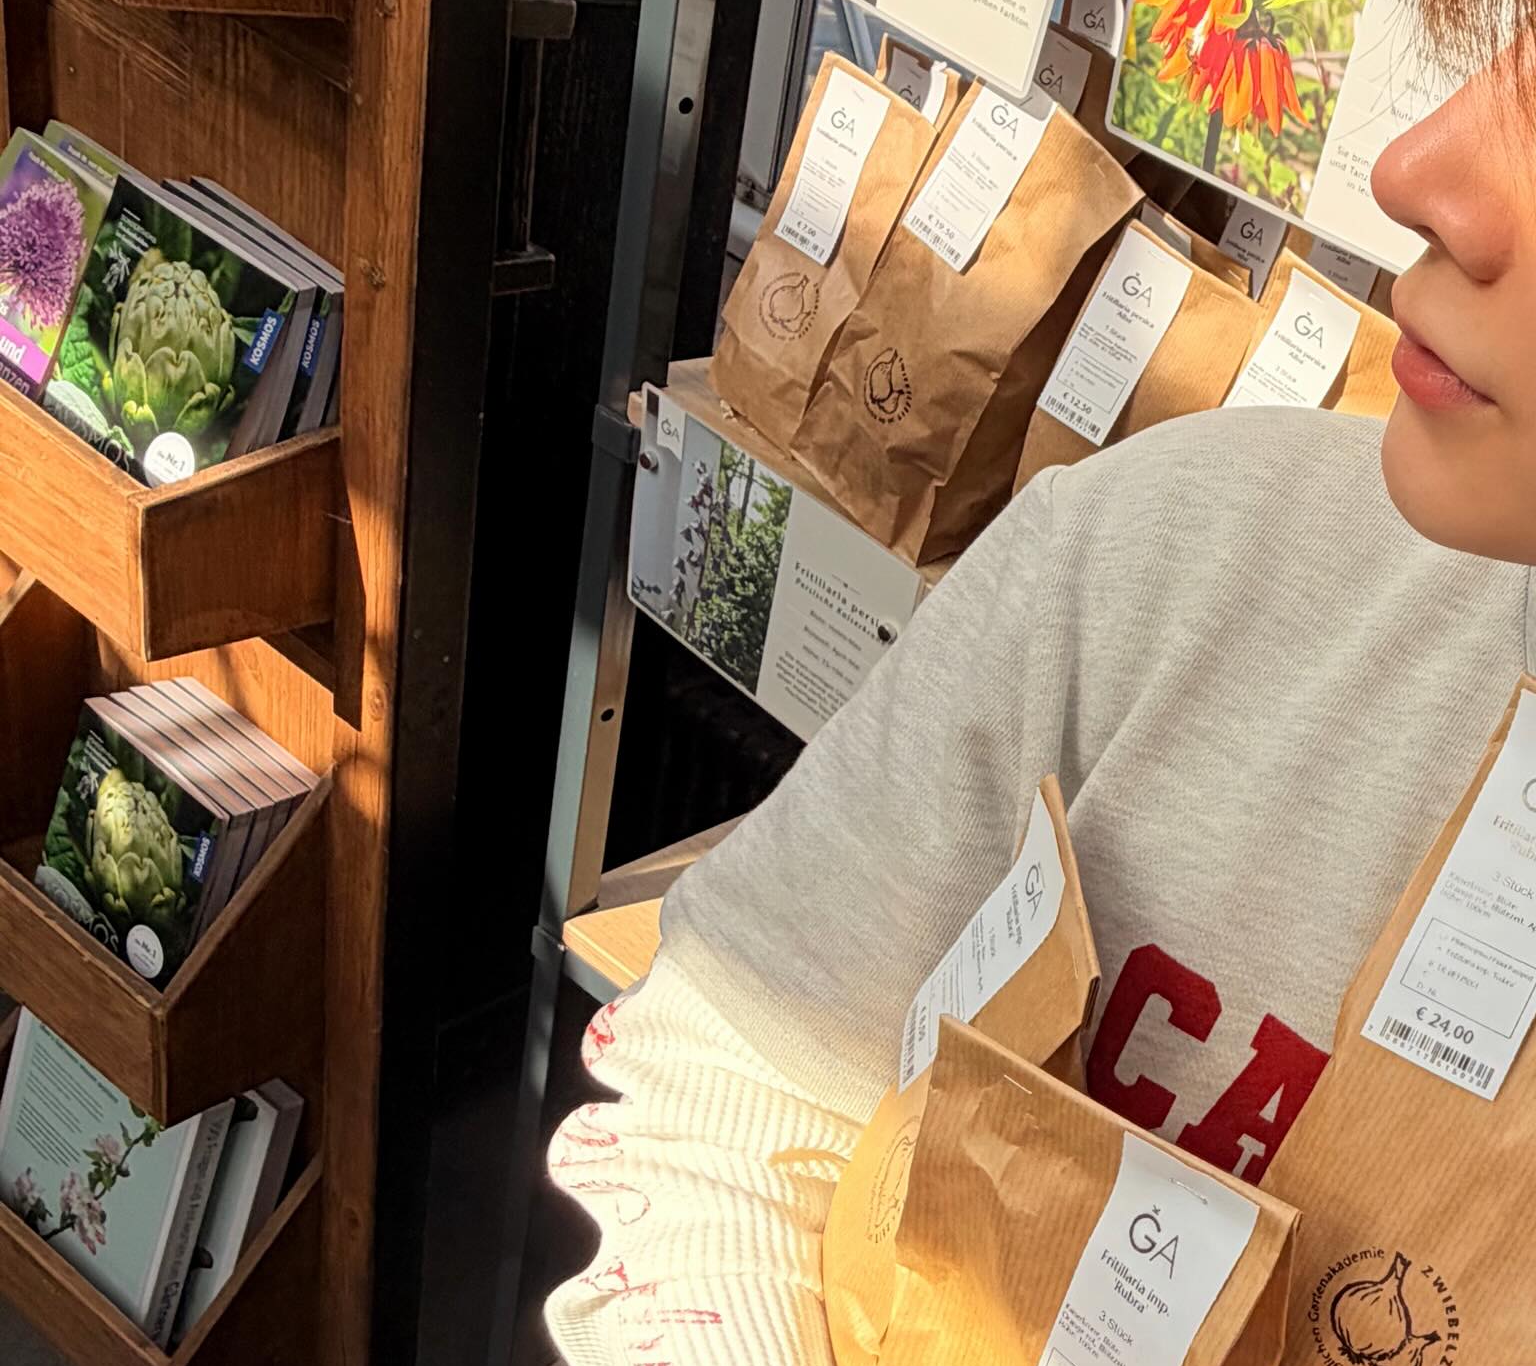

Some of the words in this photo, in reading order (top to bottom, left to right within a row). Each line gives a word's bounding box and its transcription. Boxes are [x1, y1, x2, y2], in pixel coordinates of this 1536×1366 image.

[249, 315, 278, 366] KOSMOS
[301, 318, 321, 369] KOSMOS
[1070, 396, 1093, 415] 12,50
[851, 604, 880, 627] persi
[1492, 871, 1501, 882] 3
[1502, 876, 1535, 899] Stück
[1416, 1006, 1428, 1021] €
[1428, 1013, 1474, 1045] 24,00
[1101, 1249, 1146, 1294] Fritillaria
[1147, 1288, 1170, 1317] imp.
[1114, 1277, 1149, 1314] 'Rubra'
[1308, 1247, 1385, 1322] Gartenakademie
[1099, 1310, 1106, 1322] 3
[1107, 1318, 1134, 1346] Stück
